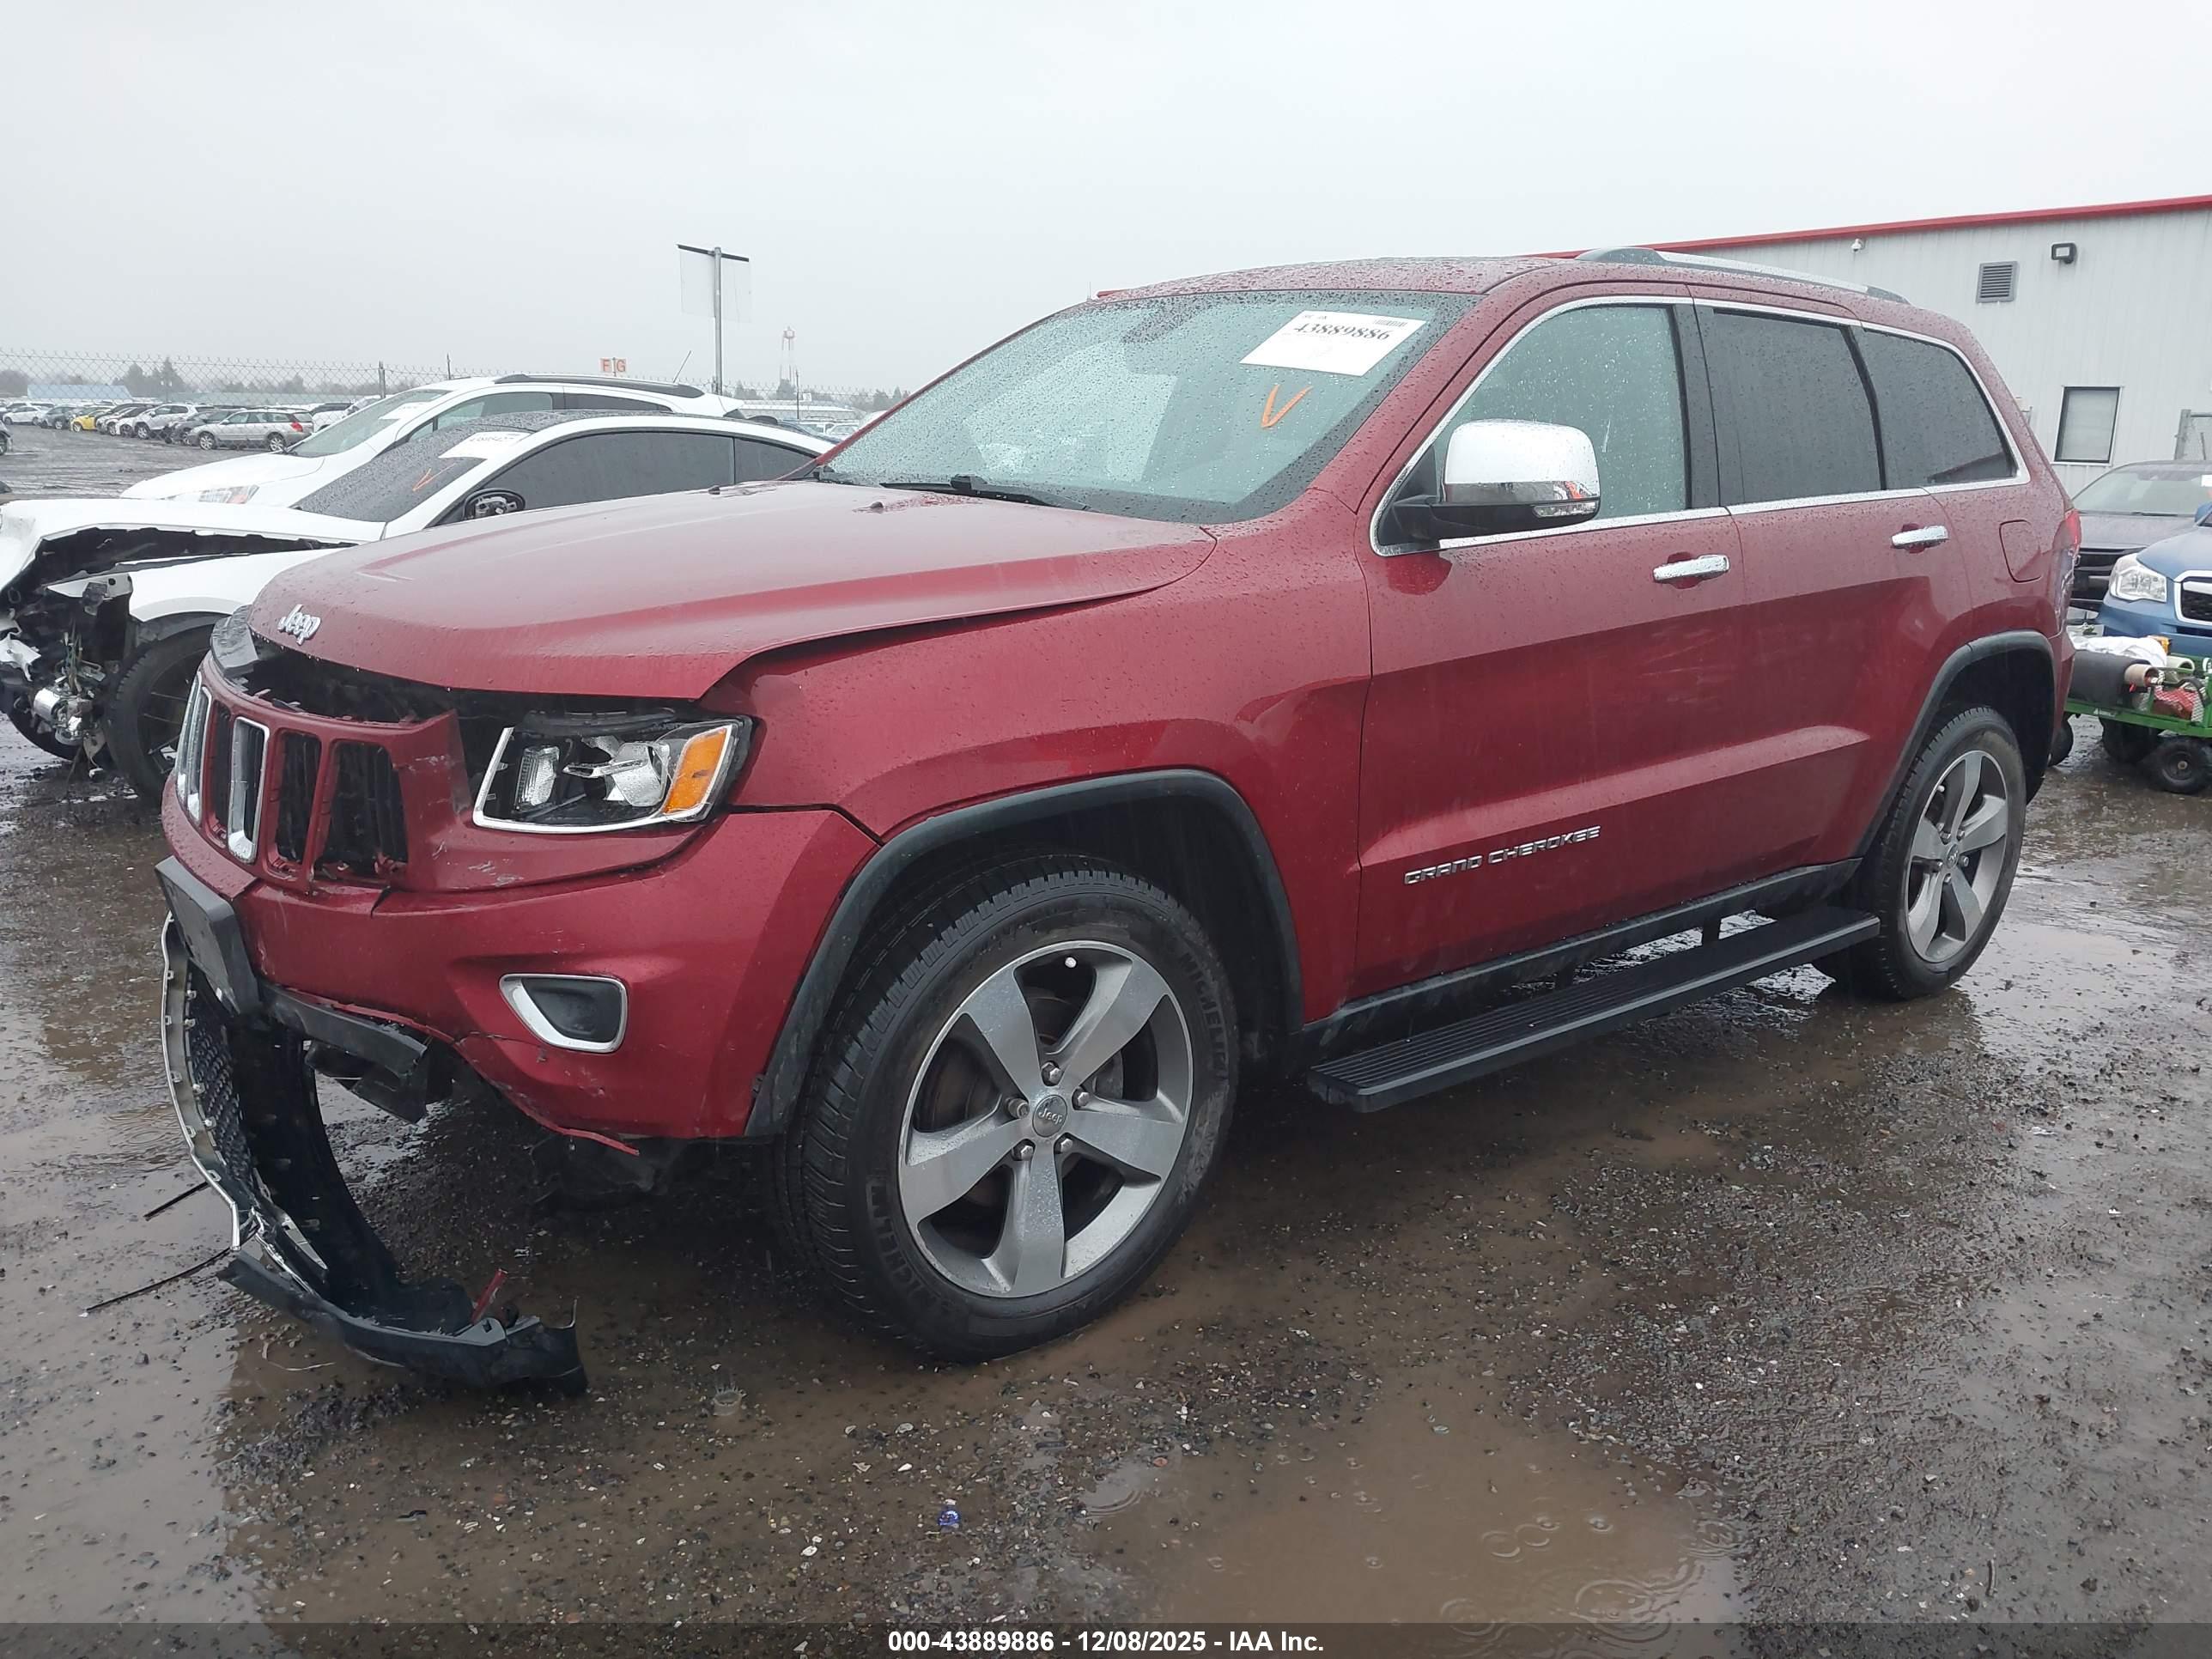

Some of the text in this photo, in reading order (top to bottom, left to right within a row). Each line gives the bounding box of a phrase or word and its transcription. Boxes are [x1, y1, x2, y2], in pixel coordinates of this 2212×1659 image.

[1294, 323, 1394, 341] 43889886
[603, 359, 626, 372] F G
[277, 604, 321, 645] Jeep
[1404, 825, 1601, 885] GRAND CHEROKEE
[1038, 1108, 1063, 1125] Jeep
